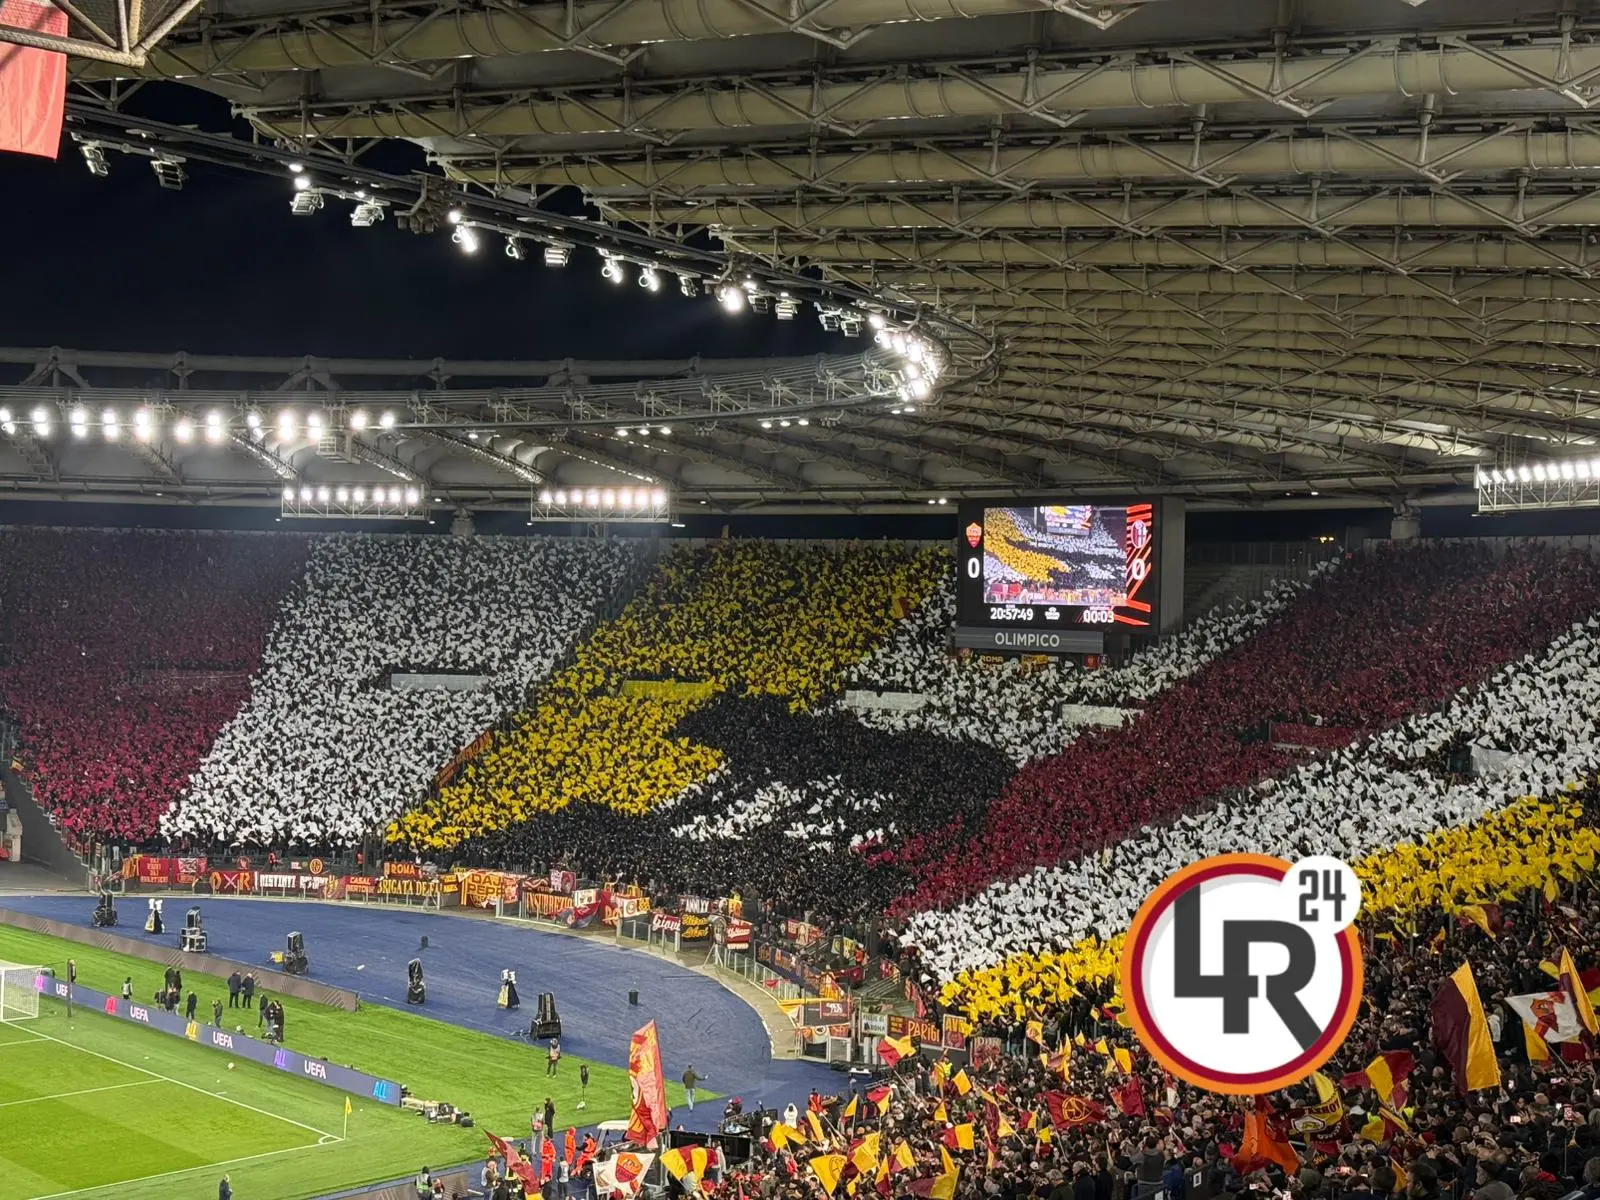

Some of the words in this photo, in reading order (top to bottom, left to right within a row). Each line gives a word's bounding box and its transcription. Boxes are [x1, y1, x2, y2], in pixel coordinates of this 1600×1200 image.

[967, 557, 980, 578] 0
[1132, 558, 1145, 580] 0
[990, 607, 1034, 621] 20:57:49
[1082, 611, 1115, 624] 00:03
[994, 632, 1060, 648] OLIMPICO
[56, 982, 72, 998] UEF
[130, 1005, 149, 1022] UEFA
[212, 1031, 233, 1049] UEFA
[304, 1060, 327, 1079] UEFA
